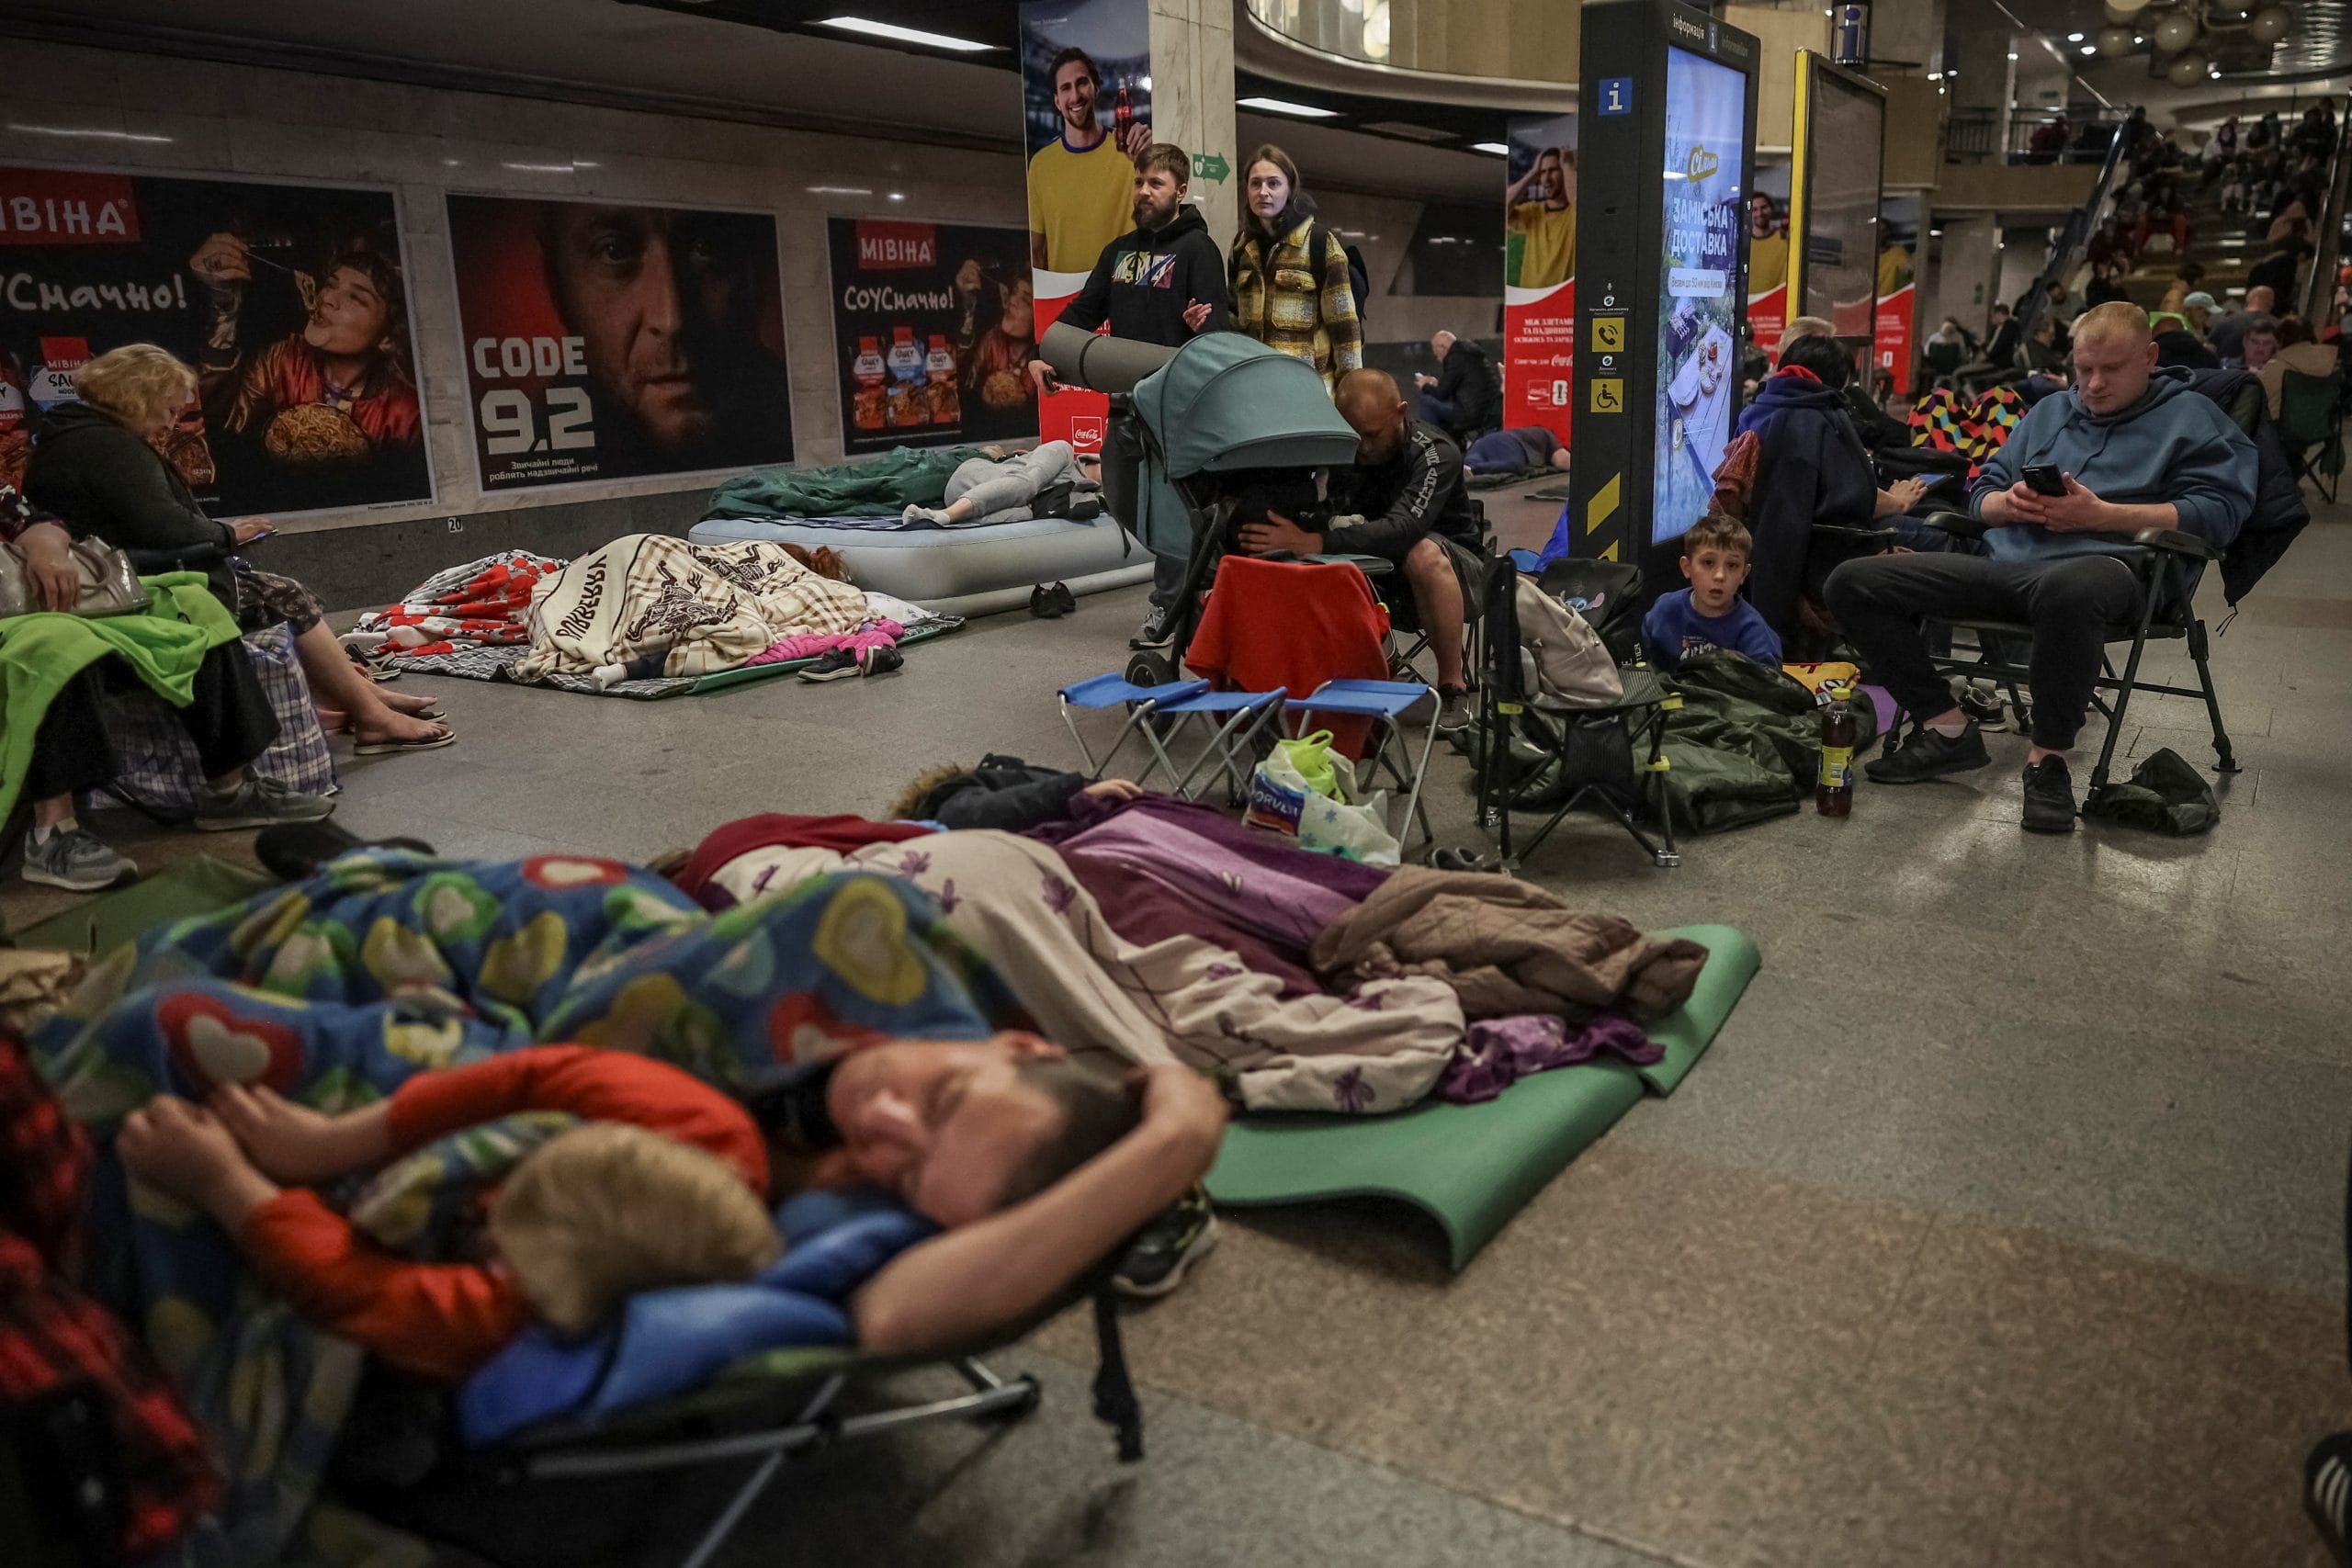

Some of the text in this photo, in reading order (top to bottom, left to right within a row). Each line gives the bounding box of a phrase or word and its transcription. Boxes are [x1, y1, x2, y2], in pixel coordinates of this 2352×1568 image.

[1673, 12, 1704, 39] інформація
[1672, 197, 1728, 229] ЗАМІСЬКА
[861, 237, 932, 262] МІВІНА
[1671, 229, 1727, 257] ДОСТАВКА
[472, 336, 588, 378] CODE
[480, 387, 595, 456] 9.2
[489, 463, 598, 483] роблять надзвичайні речі
[511, 457, 574, 470] Звичайні люди
[448, 519, 462, 531] 20
